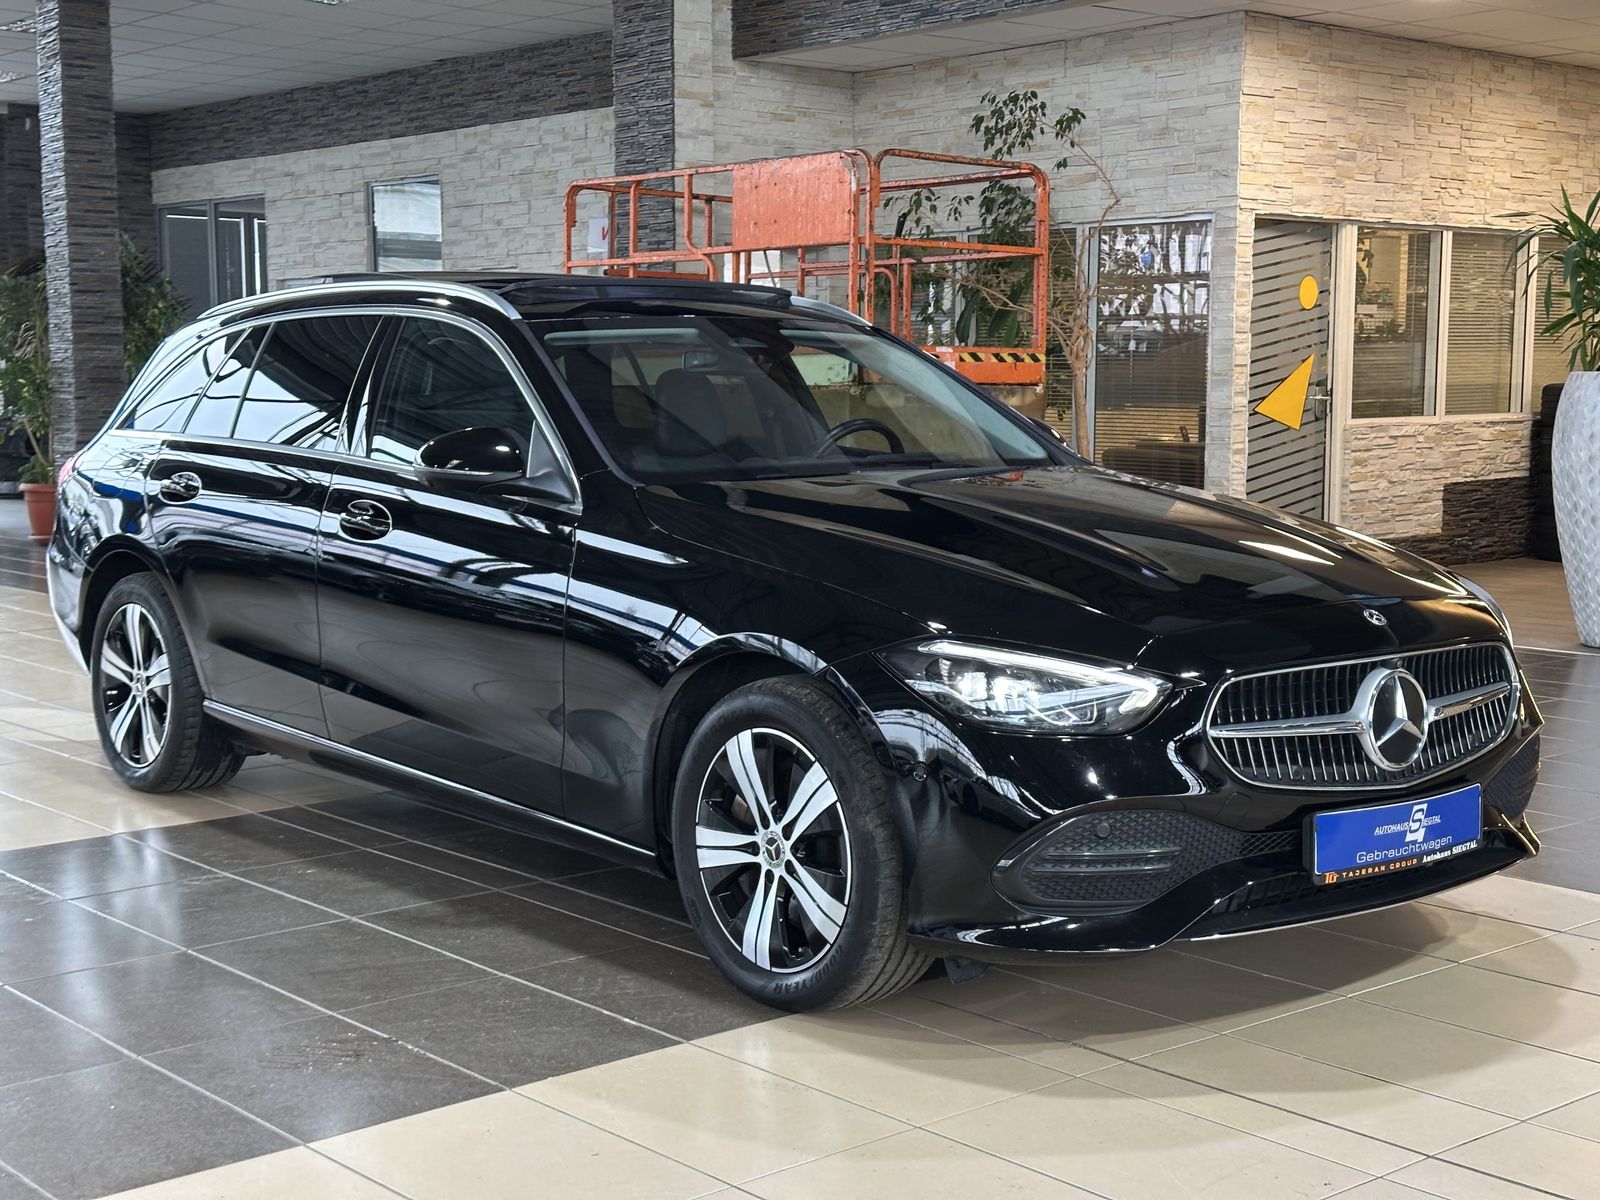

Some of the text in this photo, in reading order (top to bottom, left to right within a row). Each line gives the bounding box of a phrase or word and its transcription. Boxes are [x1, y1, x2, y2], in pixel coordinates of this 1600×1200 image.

[1374, 821, 1410, 835] AUTOHAUS
[1342, 865, 1386, 878] TAJERAN
[1389, 858, 1418, 870] GROUP
[1422, 849, 1451, 863] Autohaus
[1452, 840, 1478, 855] SIEGTAL
[1356, 835, 1452, 863] Gebrauchtwagen
[773, 944, 843, 994] GOODYEAR
